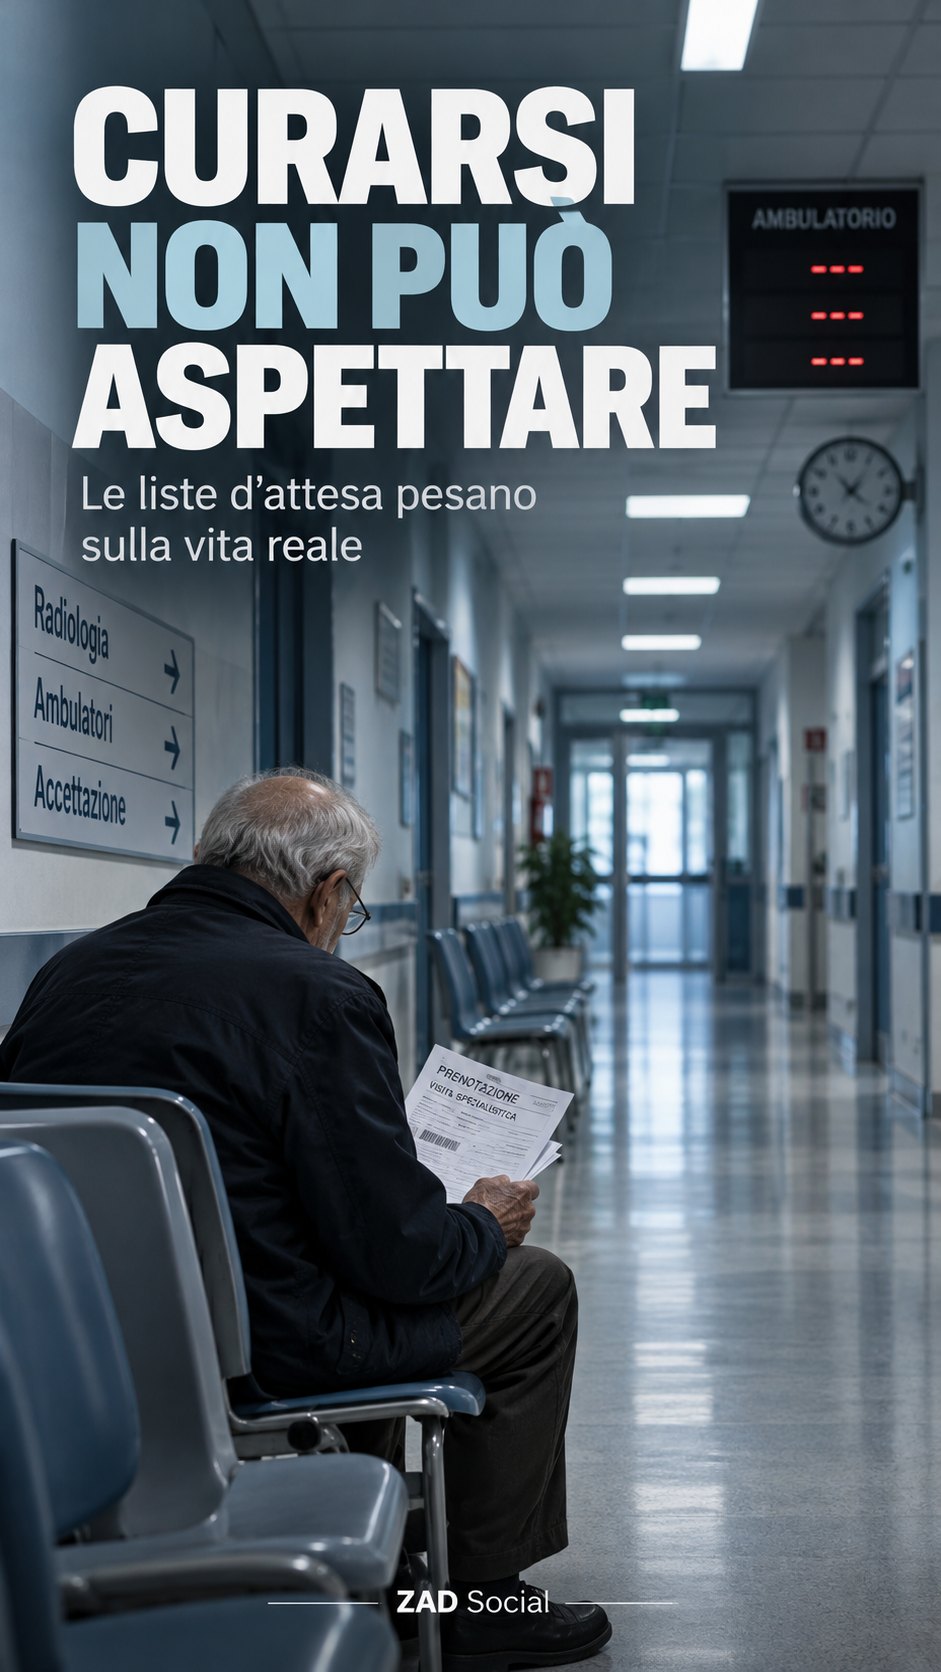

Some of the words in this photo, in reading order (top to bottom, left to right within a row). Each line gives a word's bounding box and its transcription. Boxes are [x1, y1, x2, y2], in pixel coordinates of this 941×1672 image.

[752, 207, 896, 230] AMBULATORIO
[34, 584, 110, 665] Radiologia
[33, 676, 113, 743] Ambulatori
[34, 764, 127, 826] Accettazione
[436, 1064, 520, 1105] PRENOTAZIONE
